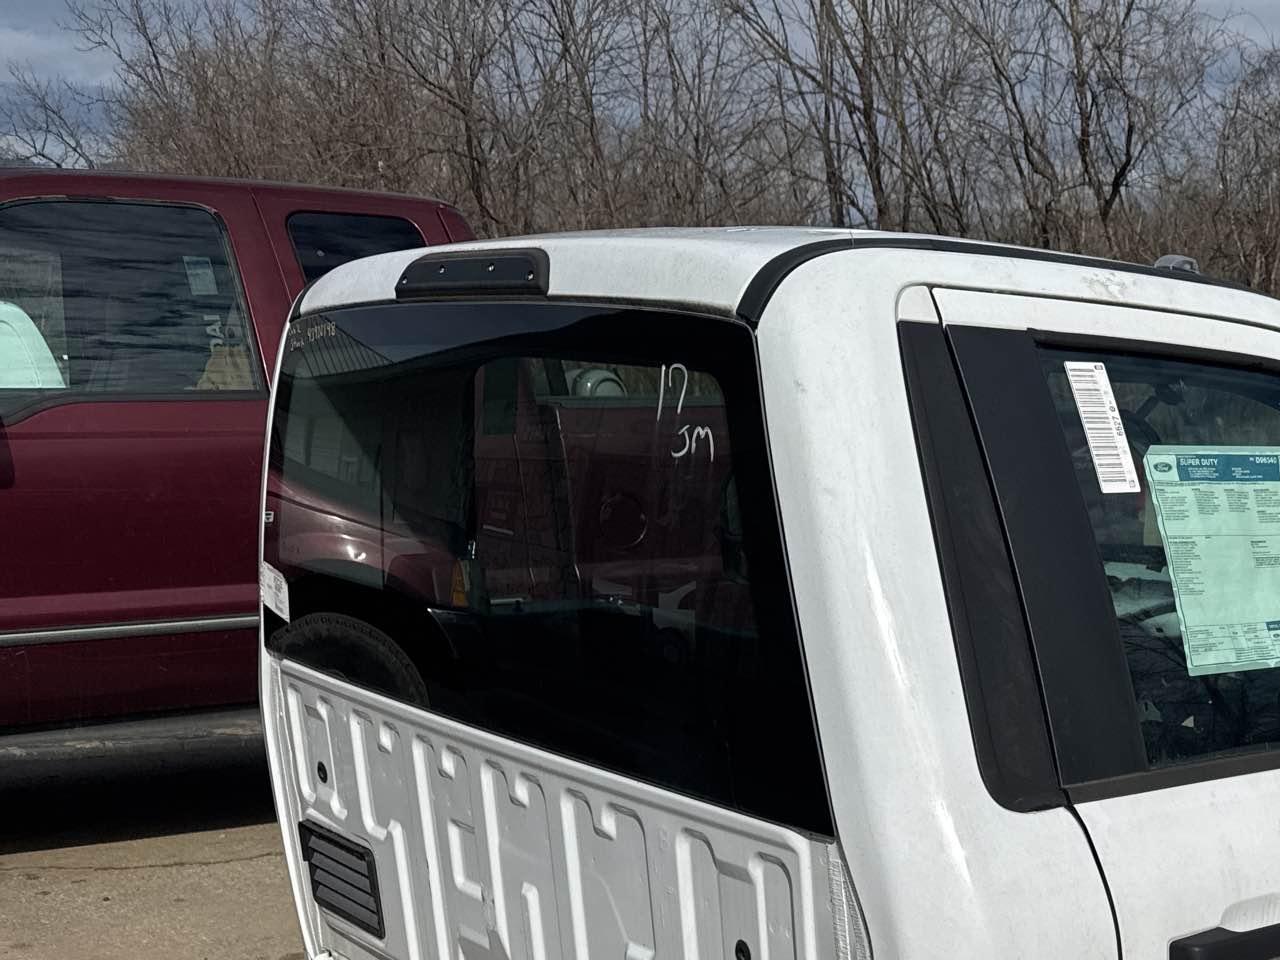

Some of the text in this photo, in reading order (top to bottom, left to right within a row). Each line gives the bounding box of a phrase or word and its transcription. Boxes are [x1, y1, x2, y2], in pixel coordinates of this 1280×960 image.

[656, 363, 688, 421] 17
[1179, 458, 1218, 466] SUPER DUTY
